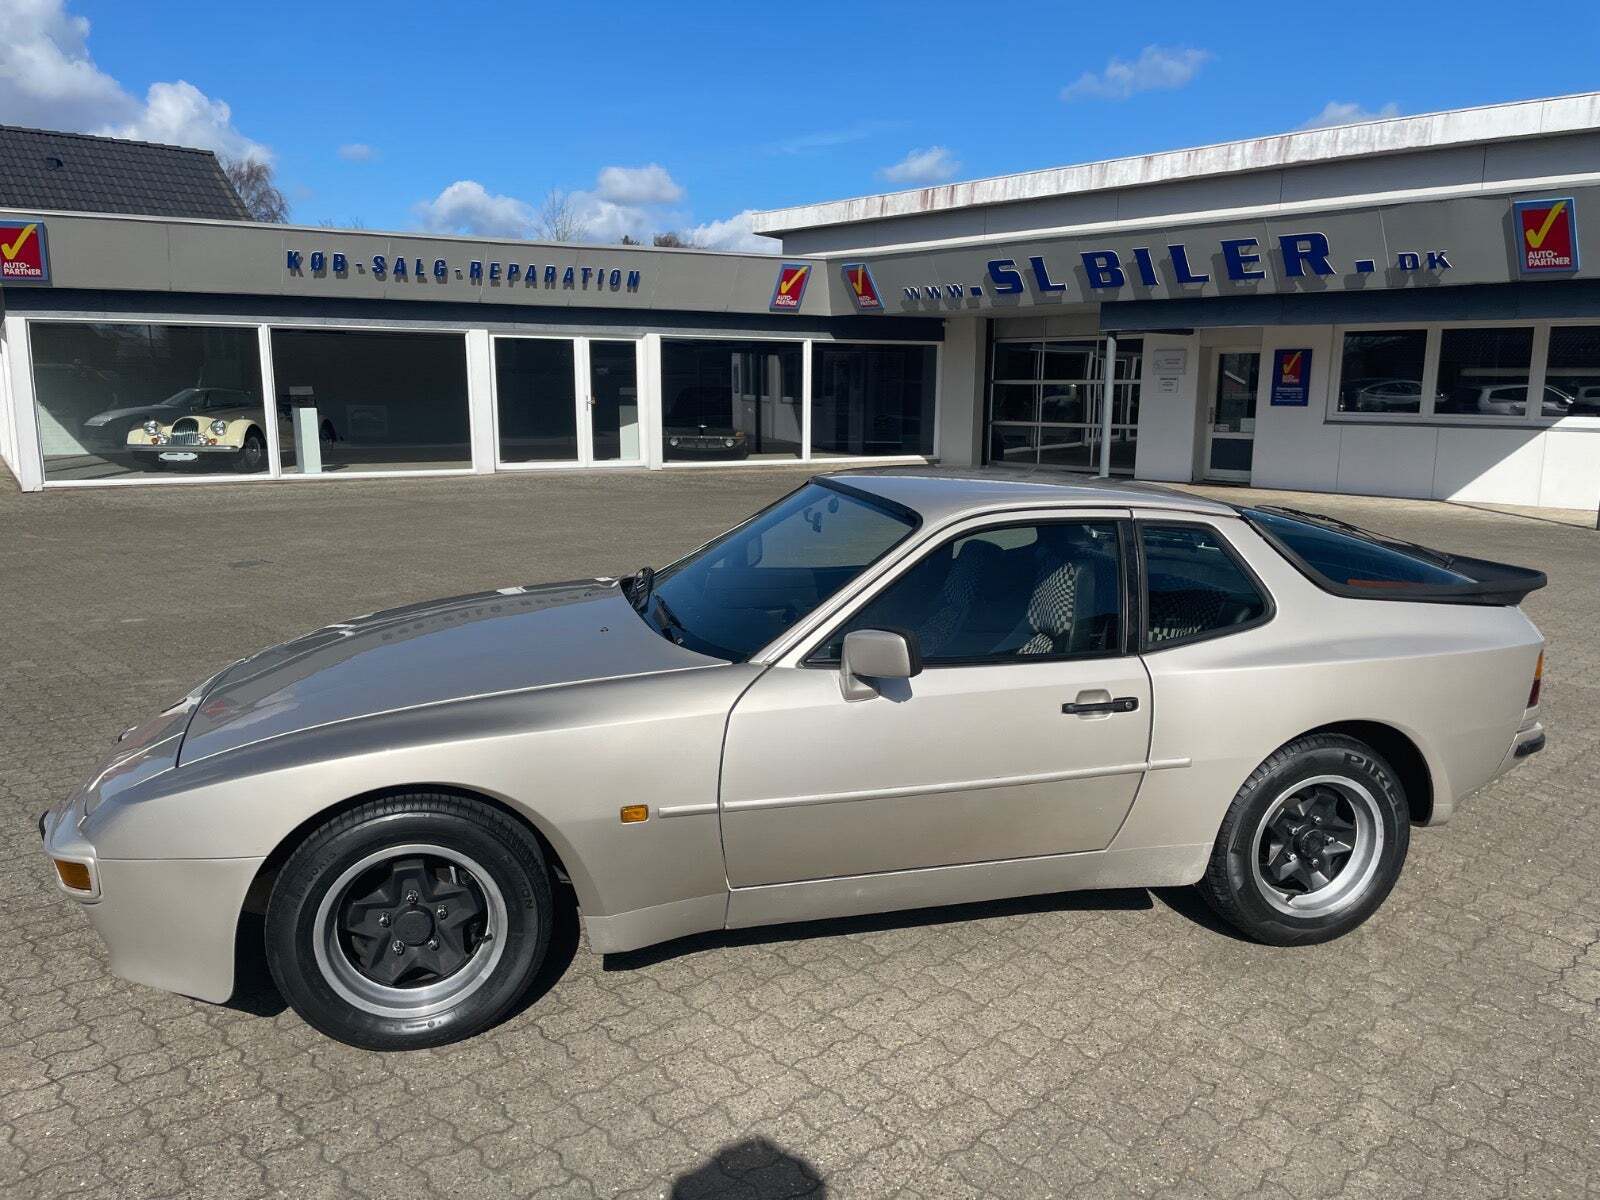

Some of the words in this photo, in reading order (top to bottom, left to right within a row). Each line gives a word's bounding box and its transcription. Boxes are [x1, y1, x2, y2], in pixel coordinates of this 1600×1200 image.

[1528, 250, 1558, 259] AUTO-
[1528, 257, 1570, 267] PARTNER
[3, 268, 41, 276] PARTNER
